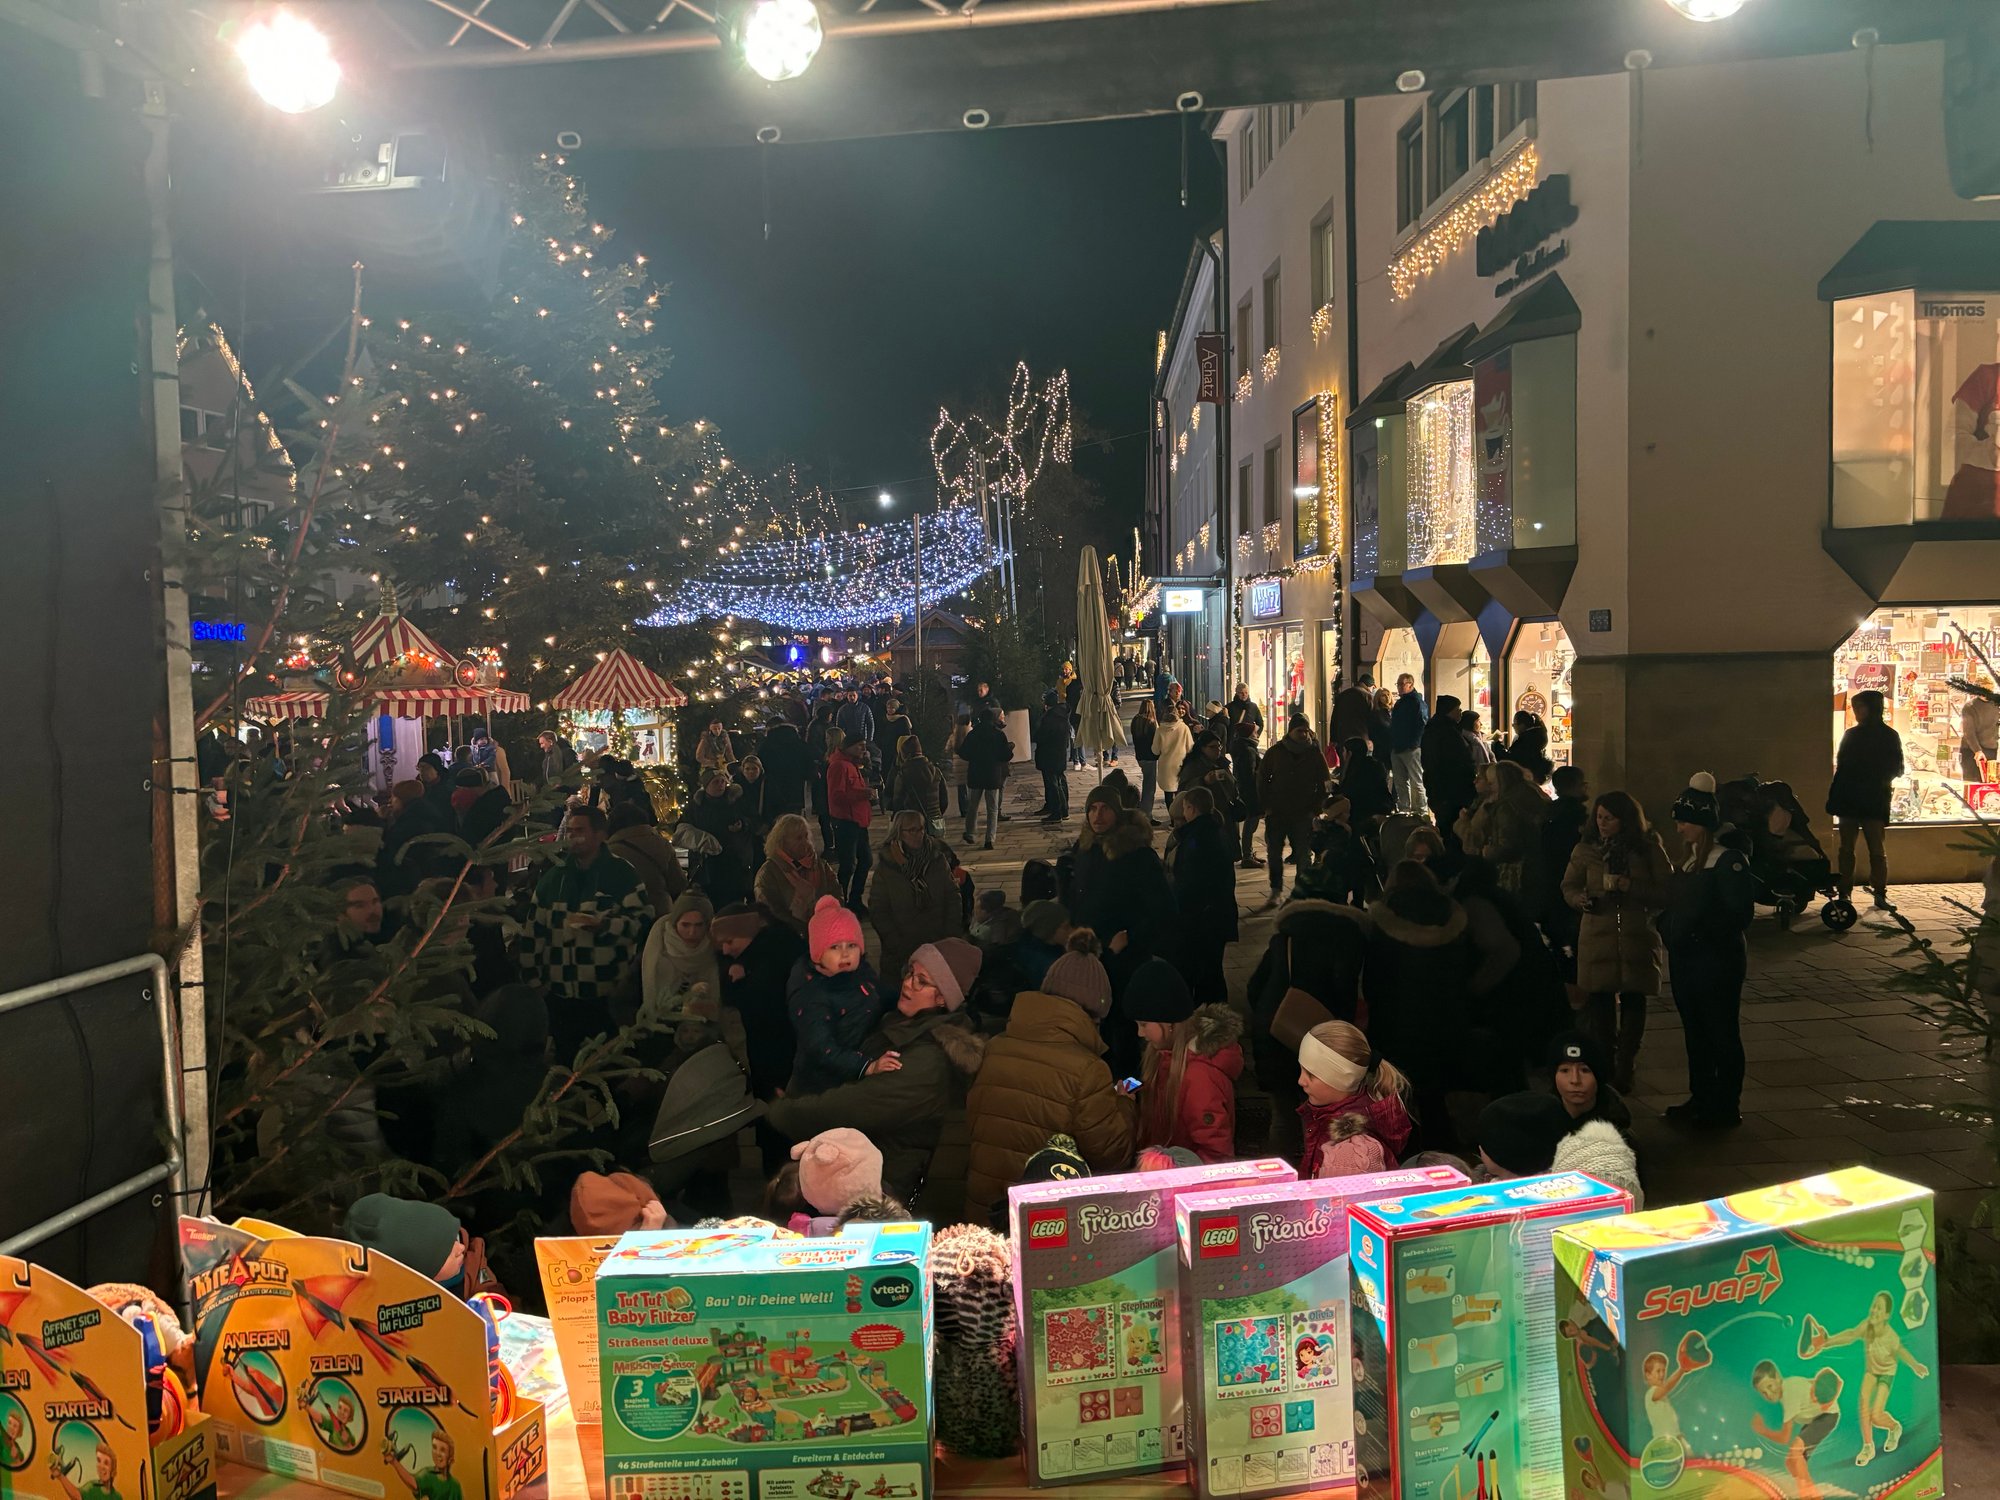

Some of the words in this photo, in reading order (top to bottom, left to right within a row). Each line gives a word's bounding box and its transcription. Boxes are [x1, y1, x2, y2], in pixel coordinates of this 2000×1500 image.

[1921, 301, 1985, 317] Thomas
[1202, 347, 1217, 397] Achatz
[1031, 1219, 1066, 1238] LEGO
[1078, 1201, 1158, 1243] Friends
[1202, 1227, 1238, 1248] LEGO
[1250, 1208, 1331, 1253] Friends
[738, 1294, 756, 1306] Dir
[760, 1293, 796, 1306] Deine
[800, 1292, 834, 1304] Welt!
[873, 1284, 909, 1296] vtech
[1637, 1273, 1766, 1320] Squap
[616, 1292, 639, 1308] Tut
[641, 1291, 663, 1306] Tut
[1121, 1299, 1165, 1312] Stephanie
[380, 1302, 418, 1322] ÖFFNET
[419, 1298, 440, 1313] SICH
[608, 1309, 647, 1326] Baby
[650, 1308, 696, 1324] Flitzer
[44, 1317, 78, 1336] ÖFFNET
[78, 1311, 100, 1327] SICH
[380, 1320, 393, 1333] IM
[394, 1315, 422, 1331] FLUG!
[45, 1337, 55, 1348] IM
[56, 1328, 83, 1345] FLUG!
[223, 1330, 289, 1350] ANLEGEN!
[608, 1337, 669, 1348] Straßenset
[672, 1336, 709, 1346] deluxe
[311, 1354, 361, 1374] ZIELEN!
[614, 1361, 660, 1375] Magischer
[662, 1360, 695, 1372] Sensor
[378, 1386, 448, 1404] STARTEN!
[631, 1379, 643, 1397] 3
[46, 1400, 109, 1419] STARTEN!
[631, 1459, 683, 1470] Straßenteile
[683, 1458, 700, 1468] und
[792, 1454, 832, 1464] Erweitern
[833, 1453, 841, 1463] &
[842, 1451, 885, 1462] Entdecken
